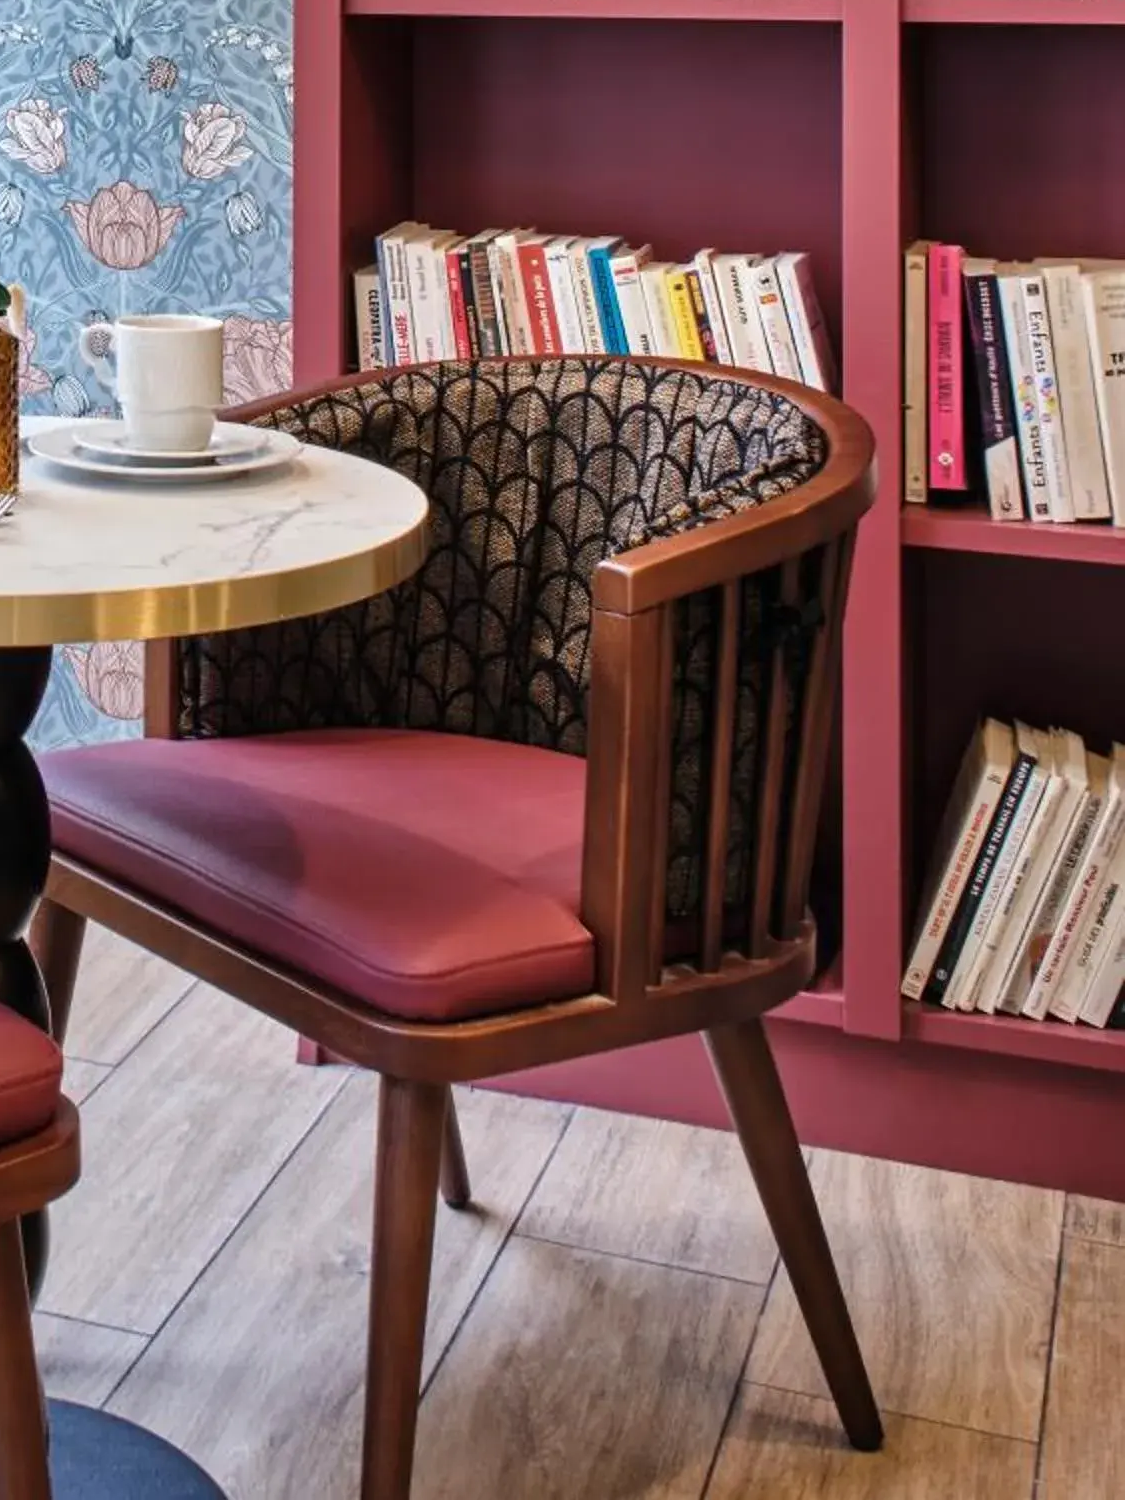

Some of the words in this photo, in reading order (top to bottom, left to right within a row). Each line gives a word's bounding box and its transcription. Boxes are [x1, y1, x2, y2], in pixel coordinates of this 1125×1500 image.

[368, 289, 381, 343] CLEOPATRA
[1028, 311, 1047, 373] Enfants
[1027, 425, 1048, 489] Enfants
[1063, 886, 1089, 933] Monsieur
